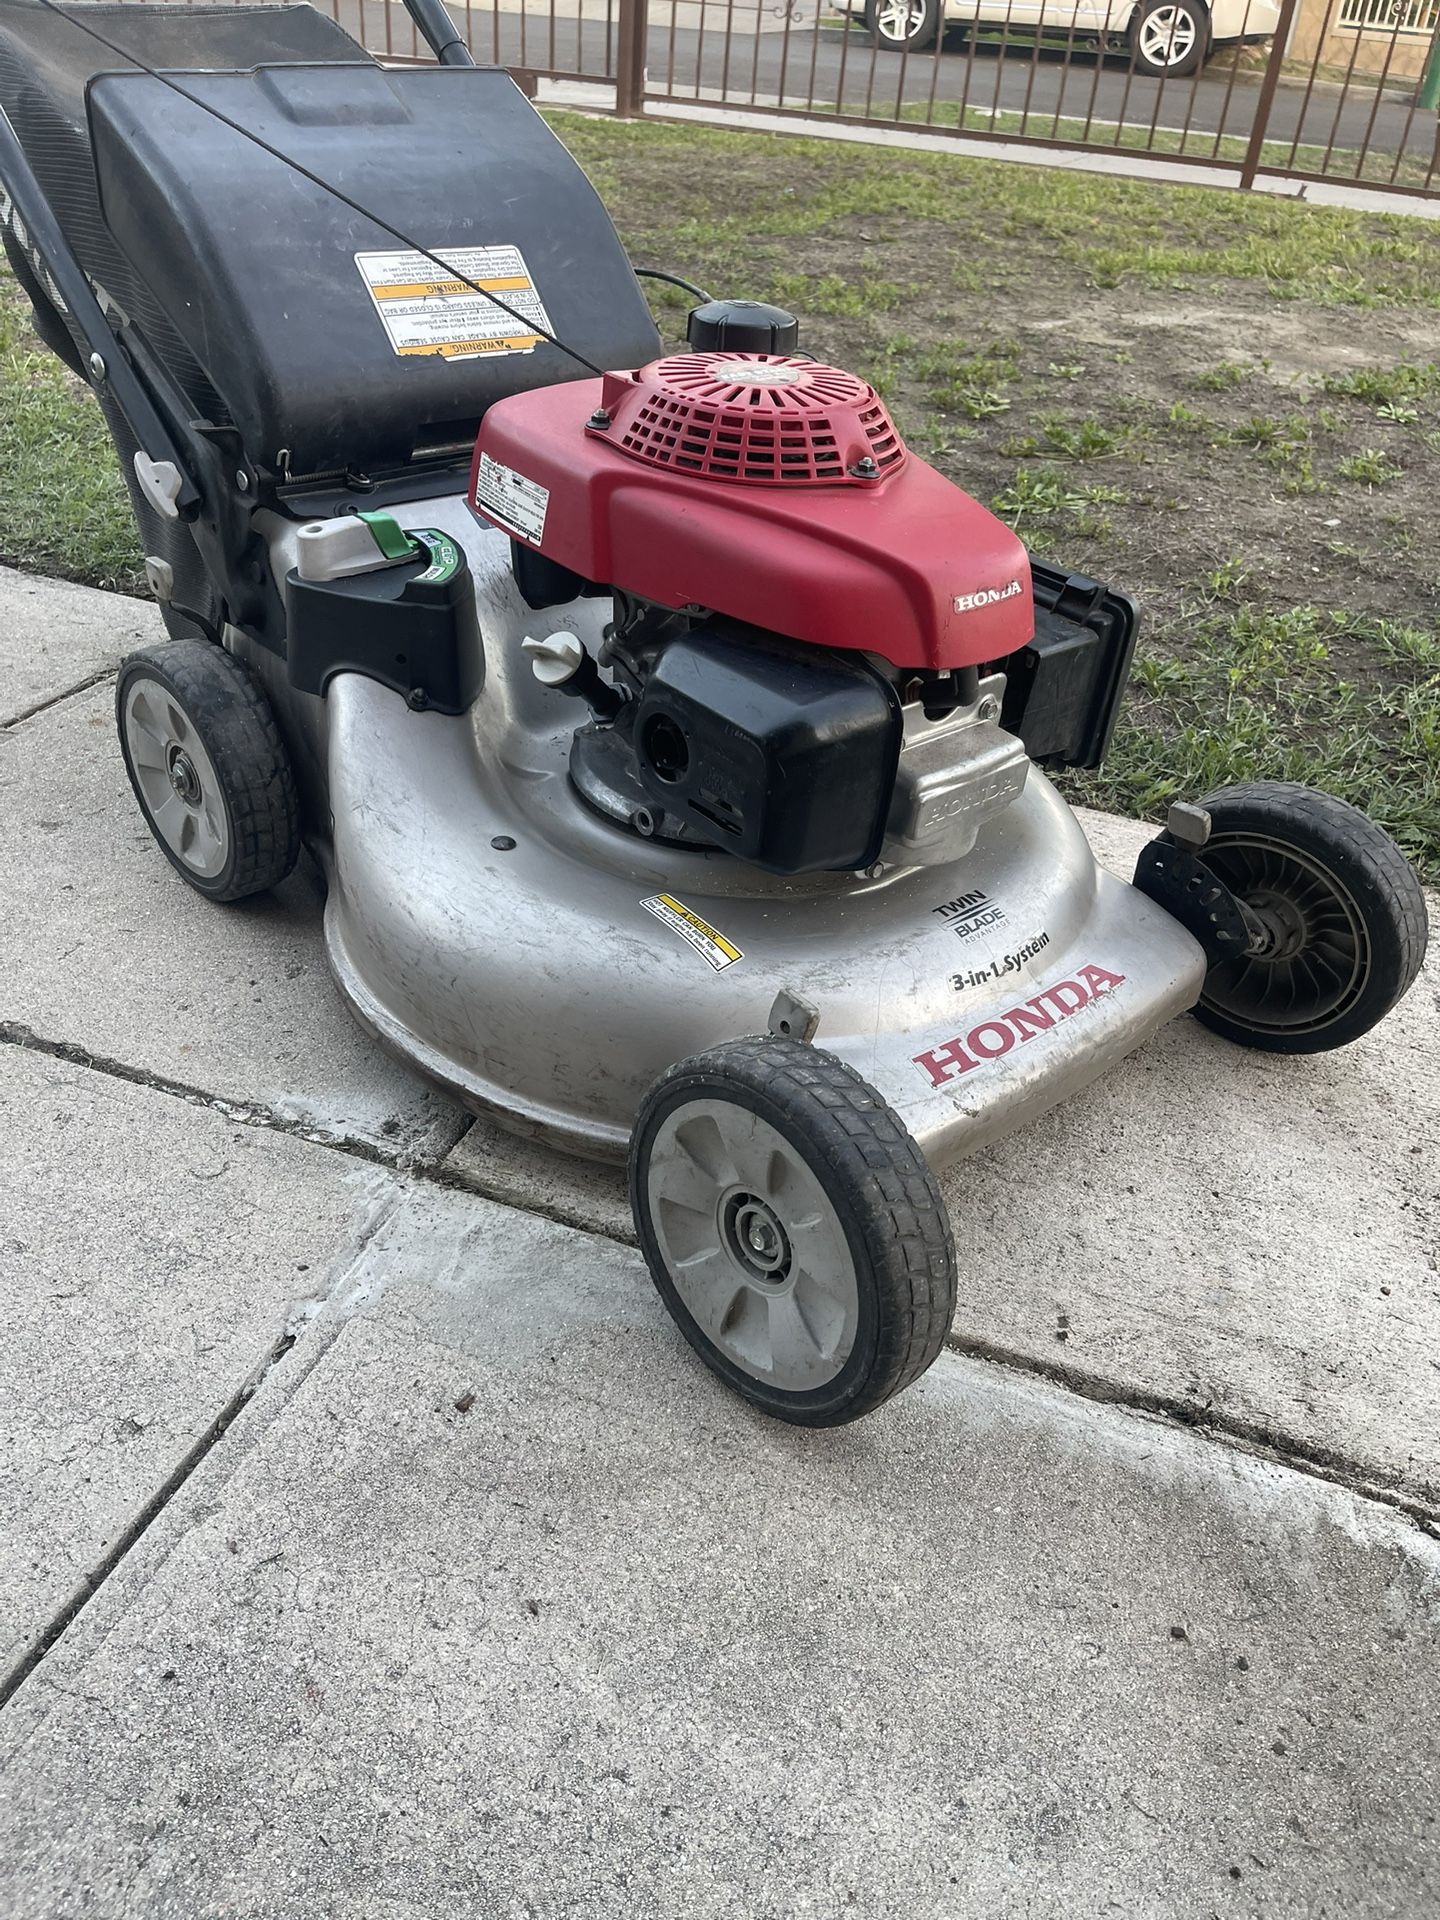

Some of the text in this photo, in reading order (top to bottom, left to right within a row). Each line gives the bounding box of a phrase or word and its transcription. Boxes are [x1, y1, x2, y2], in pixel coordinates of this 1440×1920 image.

[932, 889, 987, 917] TWIN
[688, 916, 718, 940] CAUTION
[955, 908, 1006, 938] BLADE
[964, 919, 1011, 945] ADVANTAGE
[951, 931, 1050, 991] 3-in-1 System
[912, 964, 1126, 1087] HONDA
